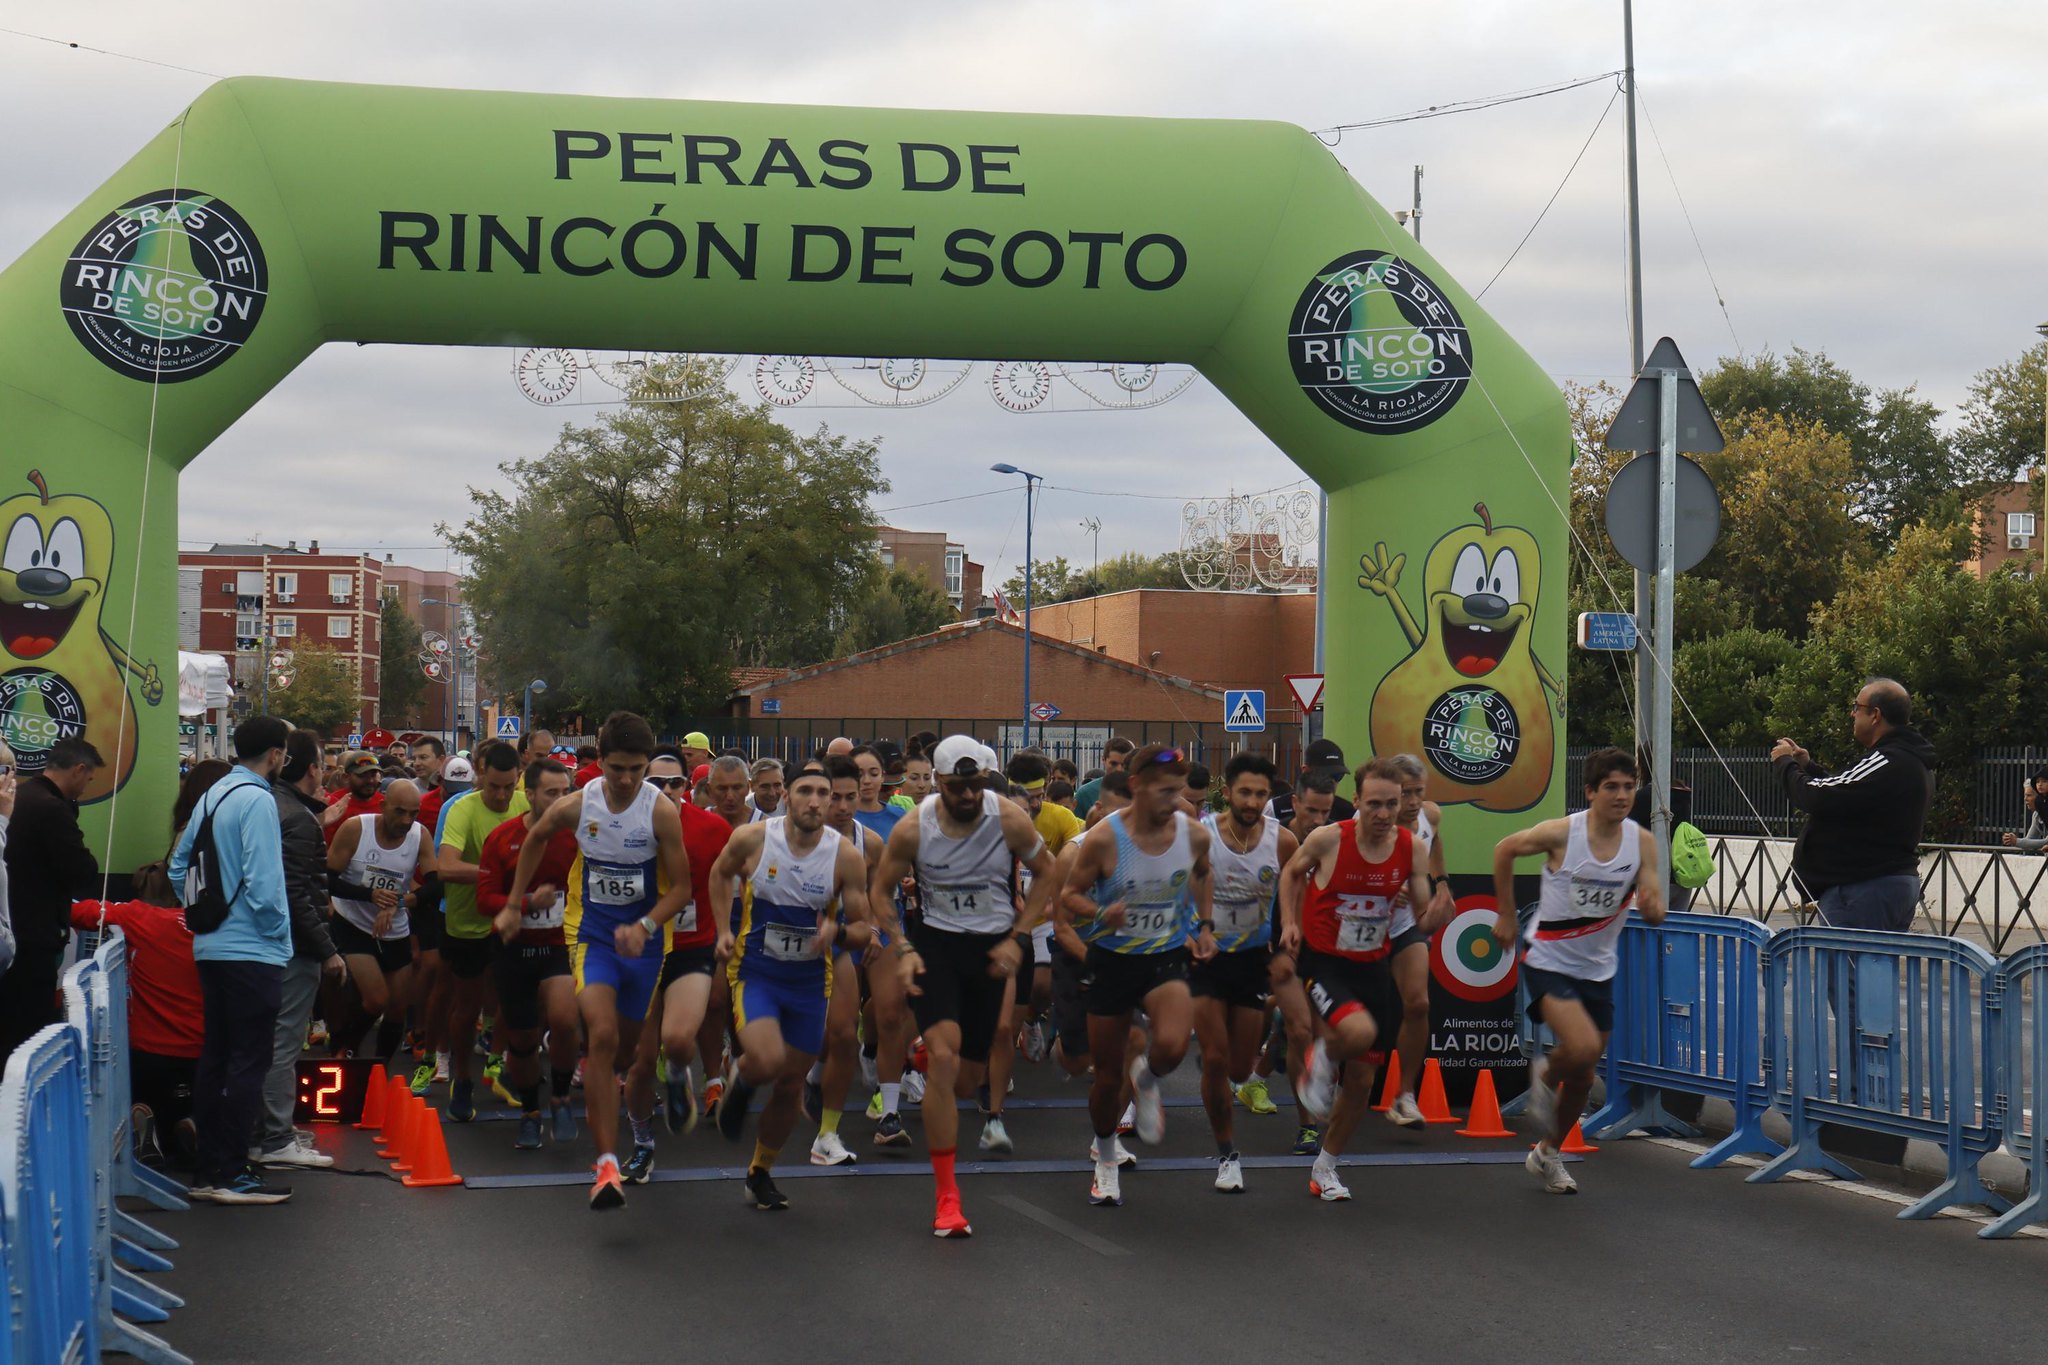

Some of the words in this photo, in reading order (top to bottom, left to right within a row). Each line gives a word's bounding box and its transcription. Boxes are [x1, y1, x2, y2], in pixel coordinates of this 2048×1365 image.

[552, 129, 873, 189] PERAS
[899, 142, 1026, 196] DE
[97, 205, 209, 254] PERAS
[213, 231, 250, 278] DE
[376, 204, 761, 281] RINCÓN
[787, 223, 916, 286] DE
[940, 228, 1188, 291] SOTO
[75, 264, 253, 321] RINCÓN
[1312, 266, 1400, 325] PERAS
[1410, 282, 1446, 321] DE
[92, 293, 134, 315] DE
[143, 302, 223, 334] SOTO
[87, 315, 136, 360] DENOMINACIÓN
[136, 356, 147, 364] DE
[148, 358, 179, 366] ORIGEN
[180, 342, 221, 364] PROTEGIDA
[113, 329, 132, 347] LA
[140, 343, 192, 357] RIOJA
[1304, 326, 1462, 363] RINCÓN
[1326, 364, 1362, 381] DE
[1373, 358, 1446, 378] SOTO
[1325, 388, 1375, 418] DENOMINACIÓN
[1388, 407, 1417, 419] ORIGEN
[1418, 381, 1450, 410] PROTEGIDA
[1351, 394, 1370, 408] LA
[1378, 391, 1427, 410] RIOJA
[56, 692, 76, 717] DE
[1440, 694, 1494, 718] PERAS
[1495, 709, 1511, 731] DE
[0, 713, 78, 738] INCÓN
[1430, 723, 1513, 752] RINCÓN
[17, 754, 46, 762] RIOJA
[1439, 740, 1459, 751] DE
[1464, 744, 1501, 759] SOTO
[1449, 757, 1458, 767] LA
[1461, 764, 1488, 772] RIOJA
[368, 877, 396, 891] 196
[596, 879, 635, 897] 185
[950, 895, 977, 911] 14
[1576, 889, 1615, 908] 348
[1127, 913, 1164, 929] 310
[1228, 910, 1237, 925] 1
[781, 936, 803, 952] 11
[1354, 926, 1377, 942] 12
[1443, 1018, 1499, 1029] Alimentos
[1501, 1018, 1514, 1029] de
[1431, 1034, 1460, 1051] LA
[1465, 1033, 1520, 1053] RIOJA
[1468, 1058, 1528, 1068] Garantizada
